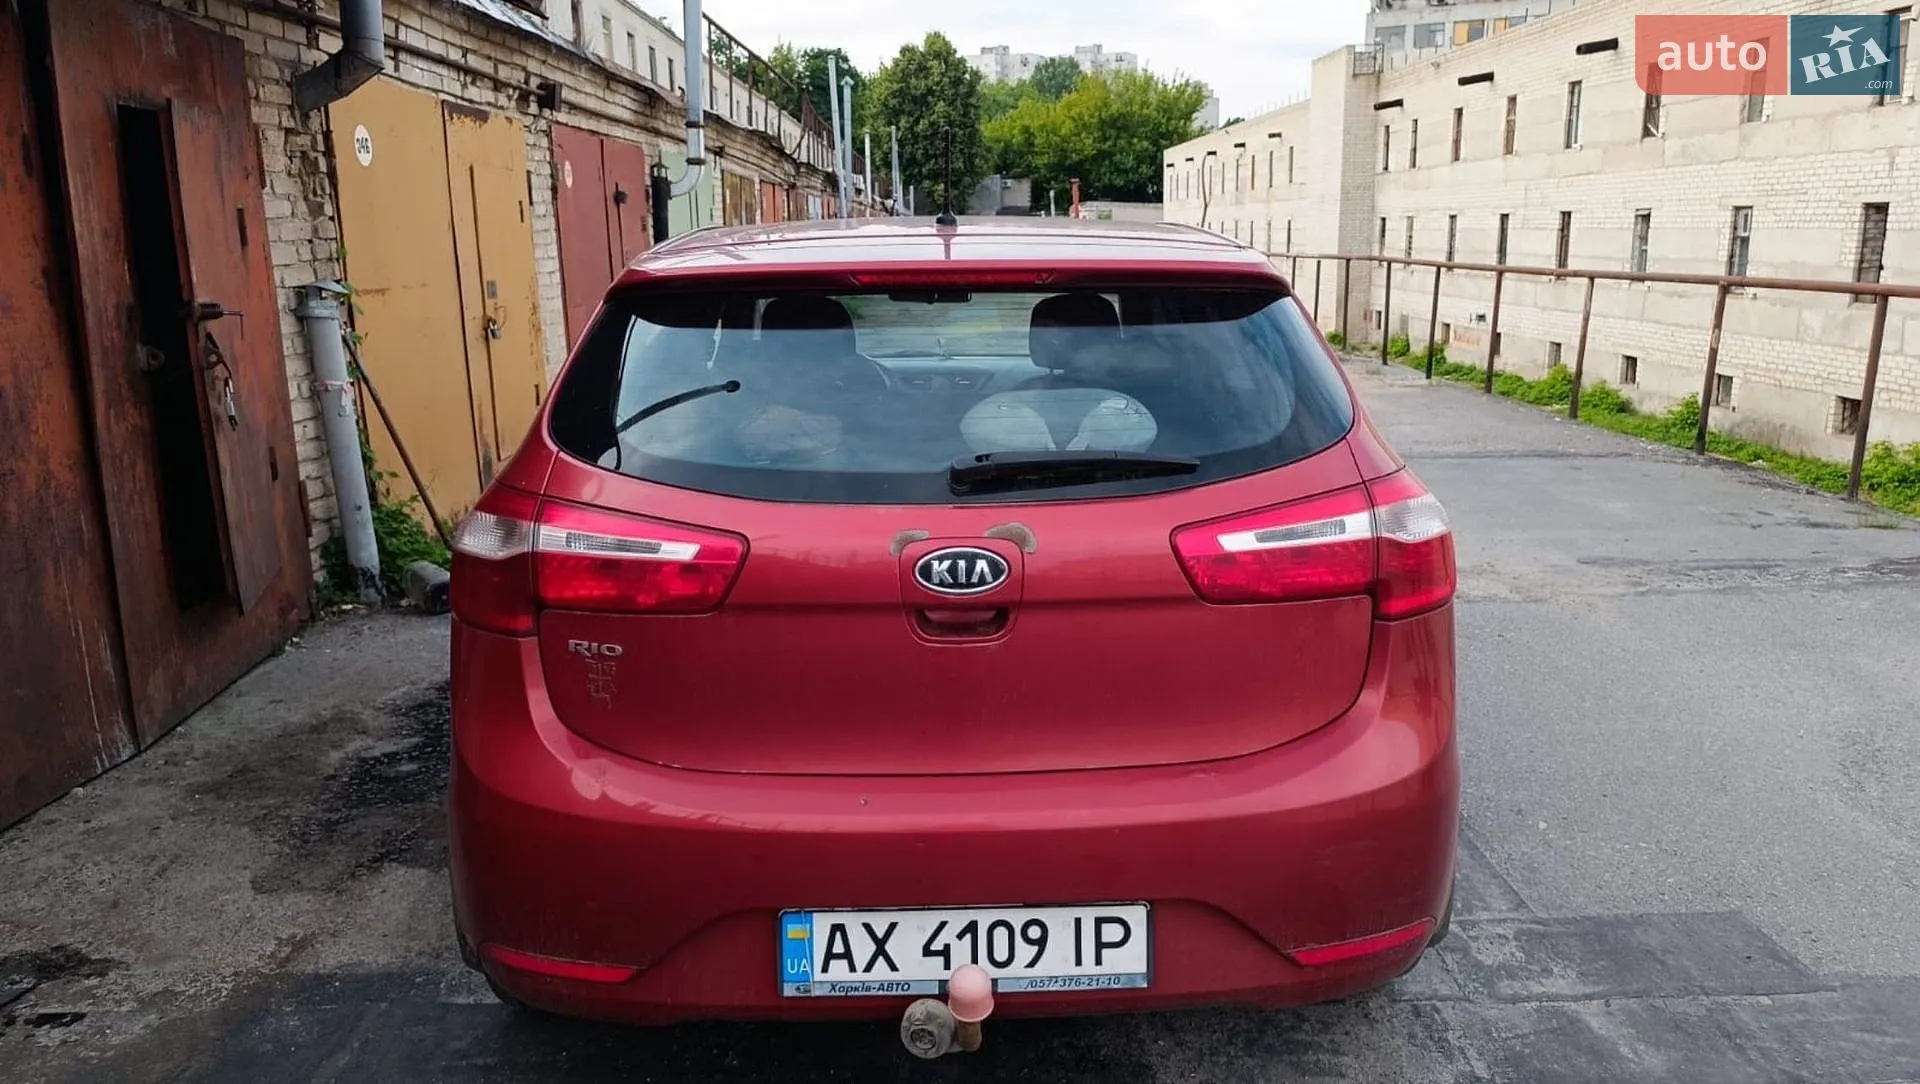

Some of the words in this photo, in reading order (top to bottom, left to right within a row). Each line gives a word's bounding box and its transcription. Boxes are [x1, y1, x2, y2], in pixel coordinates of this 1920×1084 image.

[930, 559, 994, 584] KIA
[568, 640, 623, 656] RIO
[820, 921, 900, 973] AX
[922, 918, 1049, 971] 4109
[1074, 916, 1132, 968] IP
[787, 958, 810, 974] UA
